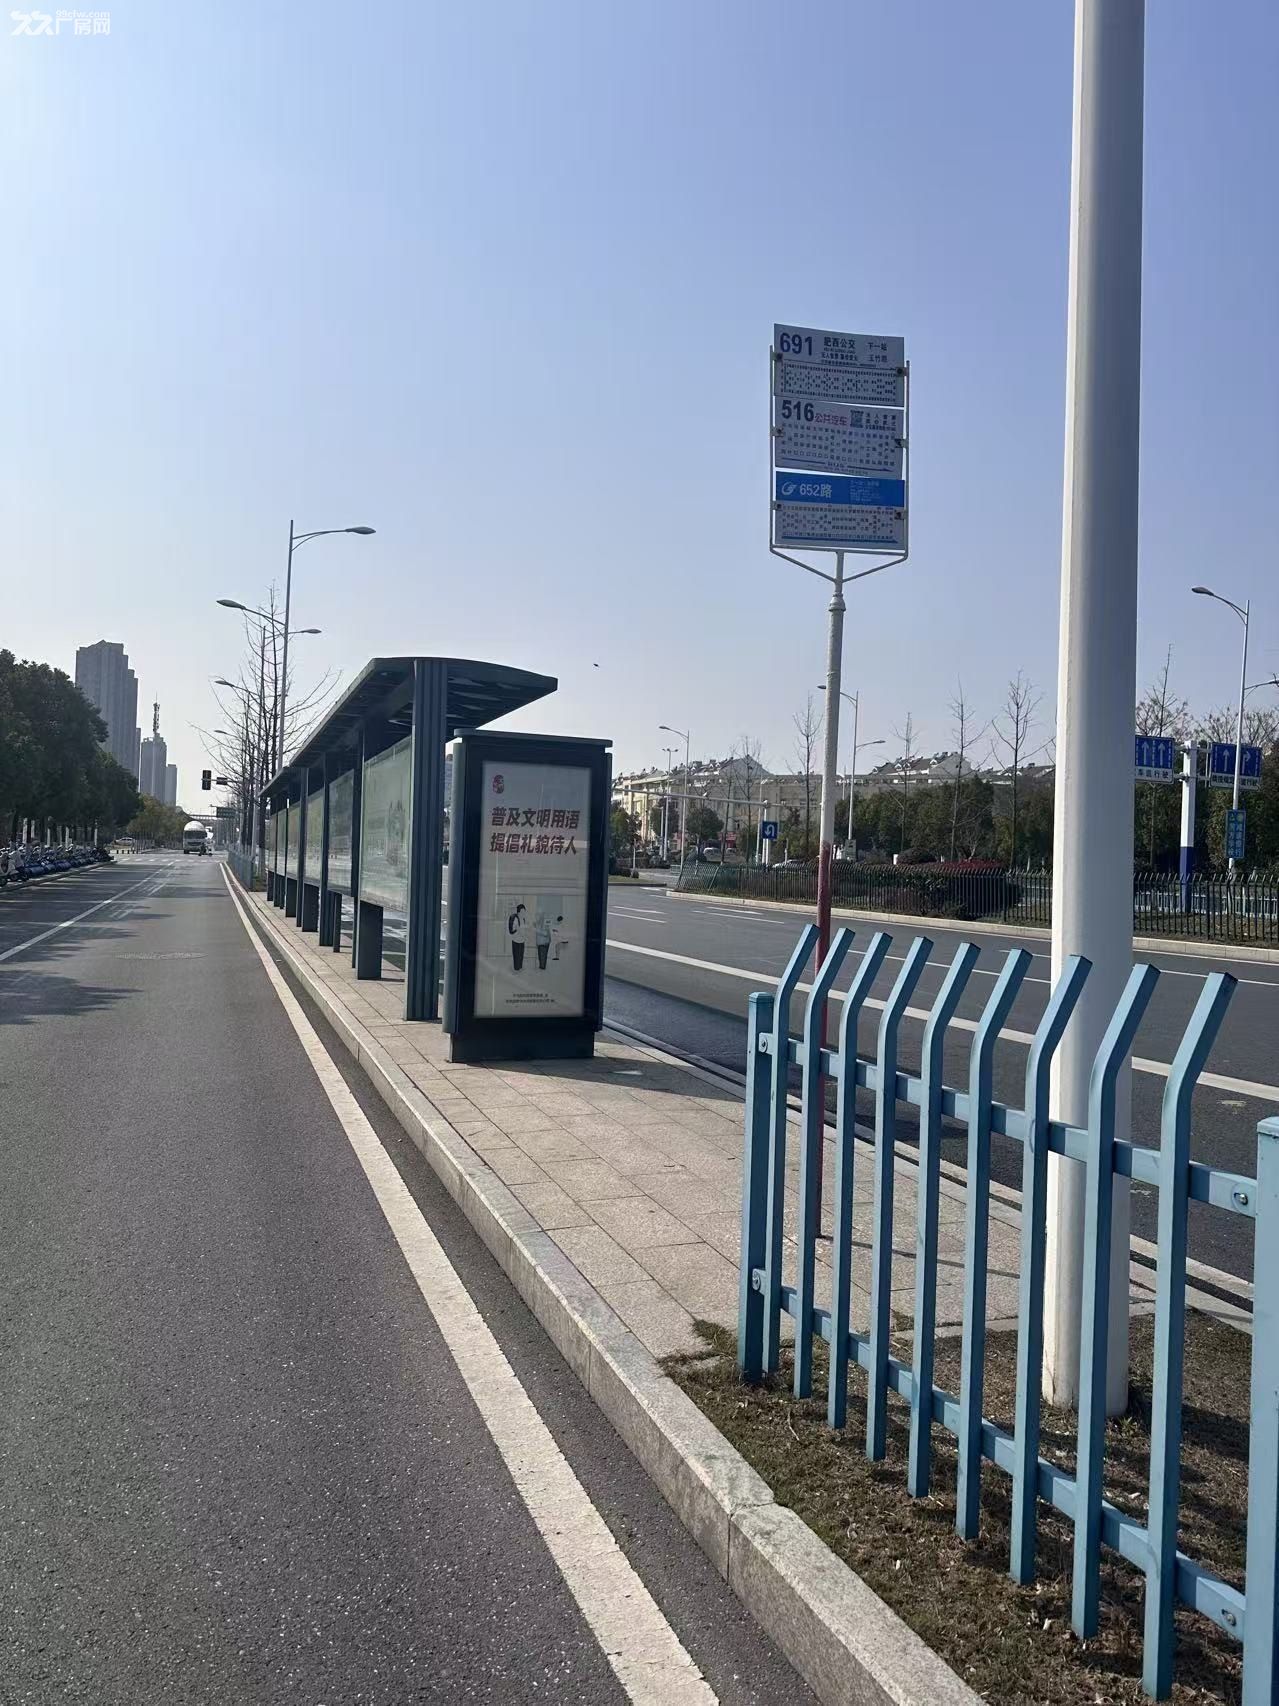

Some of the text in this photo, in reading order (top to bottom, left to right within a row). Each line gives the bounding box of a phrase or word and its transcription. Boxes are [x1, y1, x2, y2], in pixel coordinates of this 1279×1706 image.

[779, 332, 813, 357] 691
[824, 336, 856, 350] 肥西公交
[781, 399, 814, 422] 516
[814, 412, 848, 426] 公共汽车
[799, 483, 833, 498] 652路
[491, 806, 580, 830] 普及文明用语
[489, 832, 578, 855] 提倡礼貌待人
